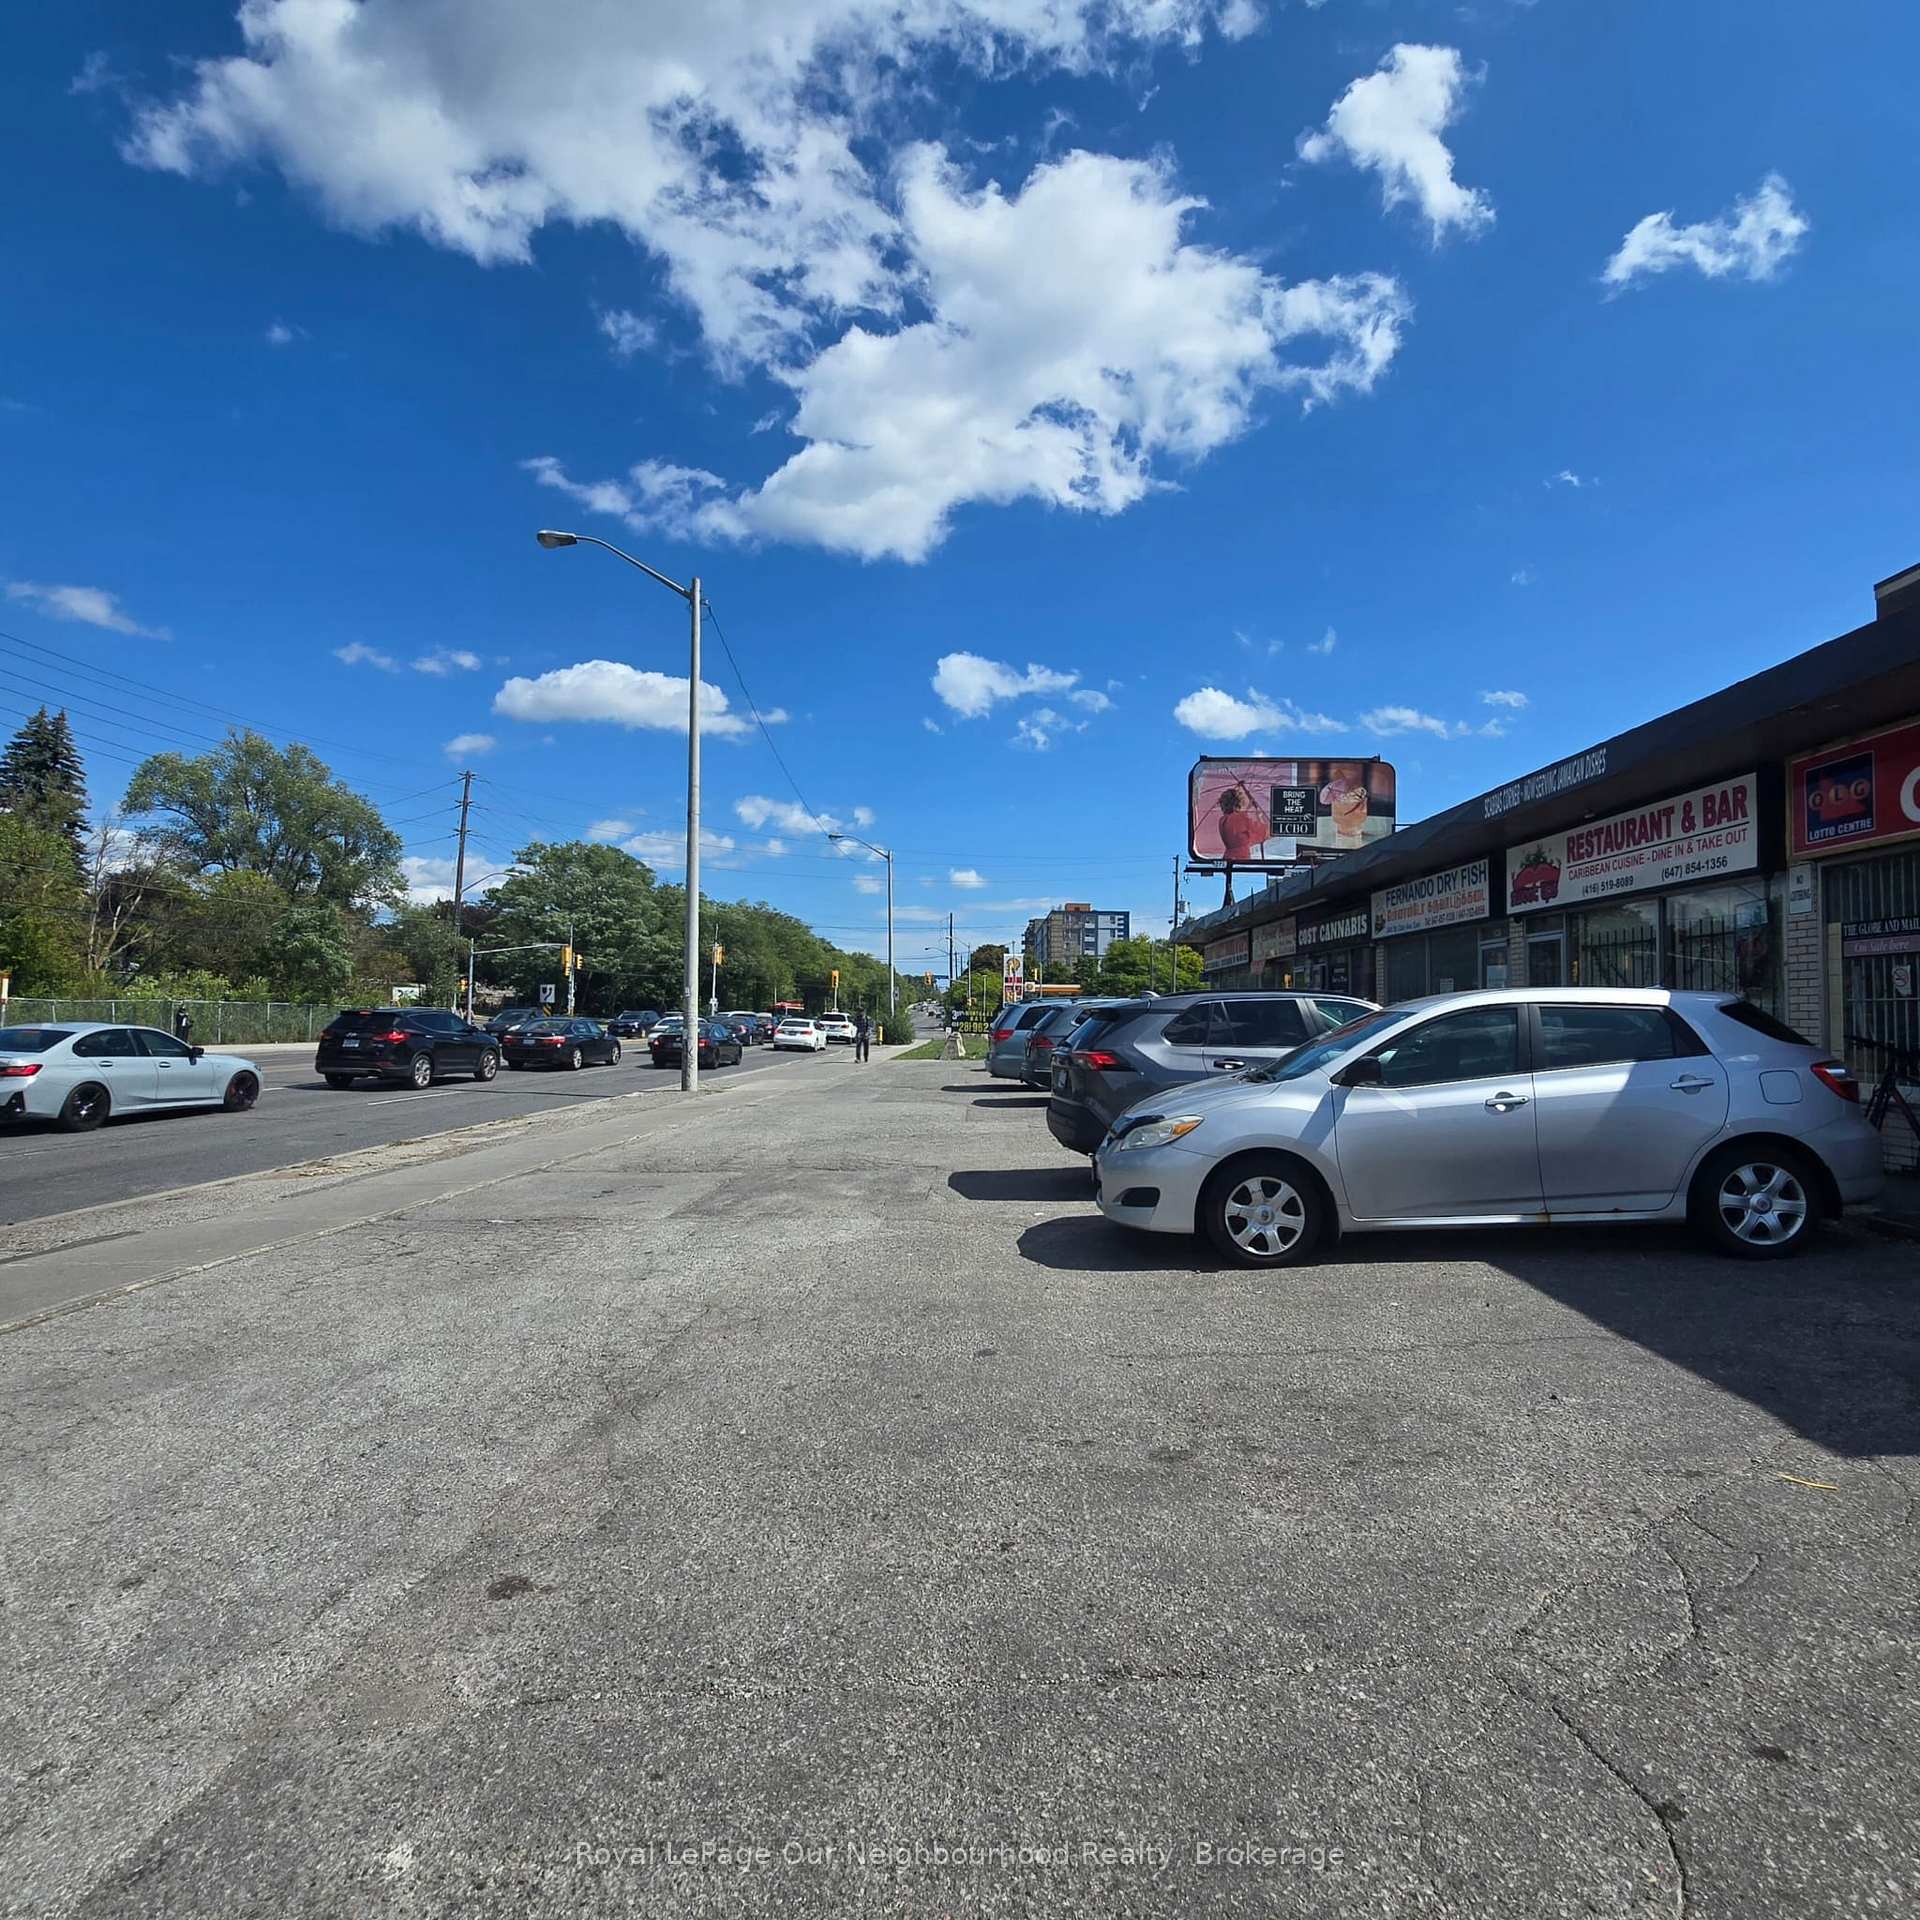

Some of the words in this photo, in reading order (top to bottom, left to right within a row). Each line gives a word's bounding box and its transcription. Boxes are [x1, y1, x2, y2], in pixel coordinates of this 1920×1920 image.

[1585, 747, 1606, 779] DISHES
[1282, 790, 1306, 798] BRING
[1286, 798, 1303, 806] THE
[1279, 823, 1309, 833] LCBO
[1566, 805, 1676, 863] RESTAURANT
[1681, 799, 1697, 834] &
[1703, 784, 1748, 828] BAR
[1809, 826, 1836, 841] LOTTO
[1837, 817, 1873, 834] CENTRE
[1568, 860, 1612, 881] CARIBBEAN
[1612, 852, 1645, 872] CUISINE
[1652, 845, 1673, 863] DINE
[1675, 843, 1684, 857] IN
[1686, 838, 1694, 854] &
[1696, 834, 1723, 852] TAKE
[1725, 829, 1748, 845] OUT
[1661, 865, 1683, 882] (647)
[1685, 855, 1728, 875] 854-1356
[1385, 879, 1434, 909] FERNANDO
[1437, 870, 1459, 895] DRY
[1460, 861, 1488, 887] FISH
[1298, 925, 1318, 946] COST
[1319, 914, 1368, 942] CANNABIS
